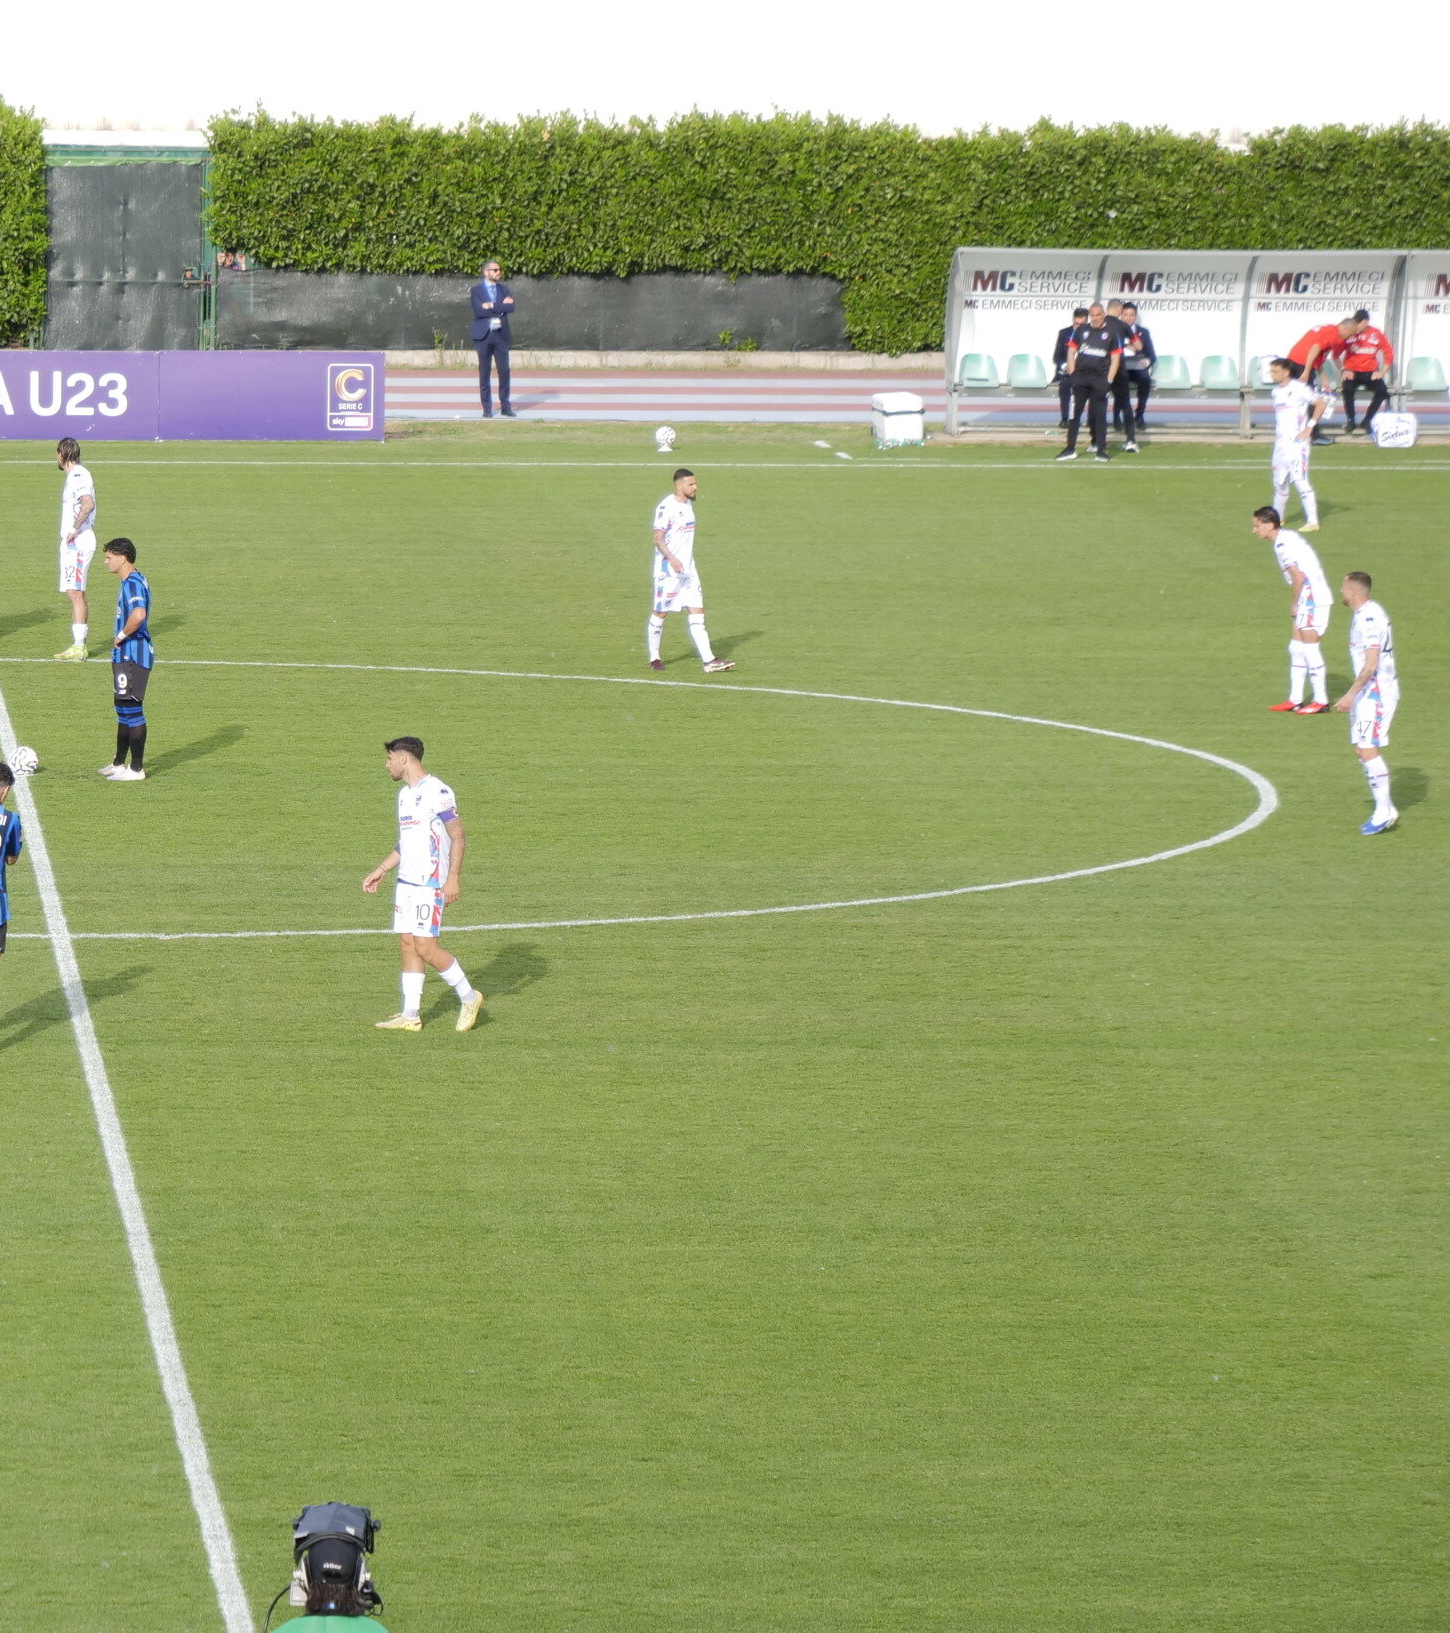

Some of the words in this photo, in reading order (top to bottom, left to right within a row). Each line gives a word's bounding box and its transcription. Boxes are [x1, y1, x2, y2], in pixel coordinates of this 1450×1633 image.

[972, 270, 1016, 292] MC
[1019, 270, 1091, 280] EMMECI
[1017, 281, 1088, 294] SERVICE
[1119, 272, 1163, 293] MC
[1165, 272, 1238, 283] EMMECI
[1266, 272, 1310, 295] MC
[1312, 271, 1385, 283] EMMECI
[1164, 283, 1235, 295] SERVICE
[1310, 282, 1381, 295] SERVICE
[963, 299, 979, 309] MC
[981, 299, 1032, 310] EMMECI
[1034, 299, 1088, 310] SERVICE
[1181, 301, 1233, 312] SERVICE
[1256, 301, 1272, 312] MC
[1274, 300, 1324, 312] EMMECI
[29, 371, 128, 417] U23
[338, 402, 357, 410] SERIE
[357, 402, 363, 410] C
[117, 673, 128, 690] 9
[414, 903, 431, 921] 10
